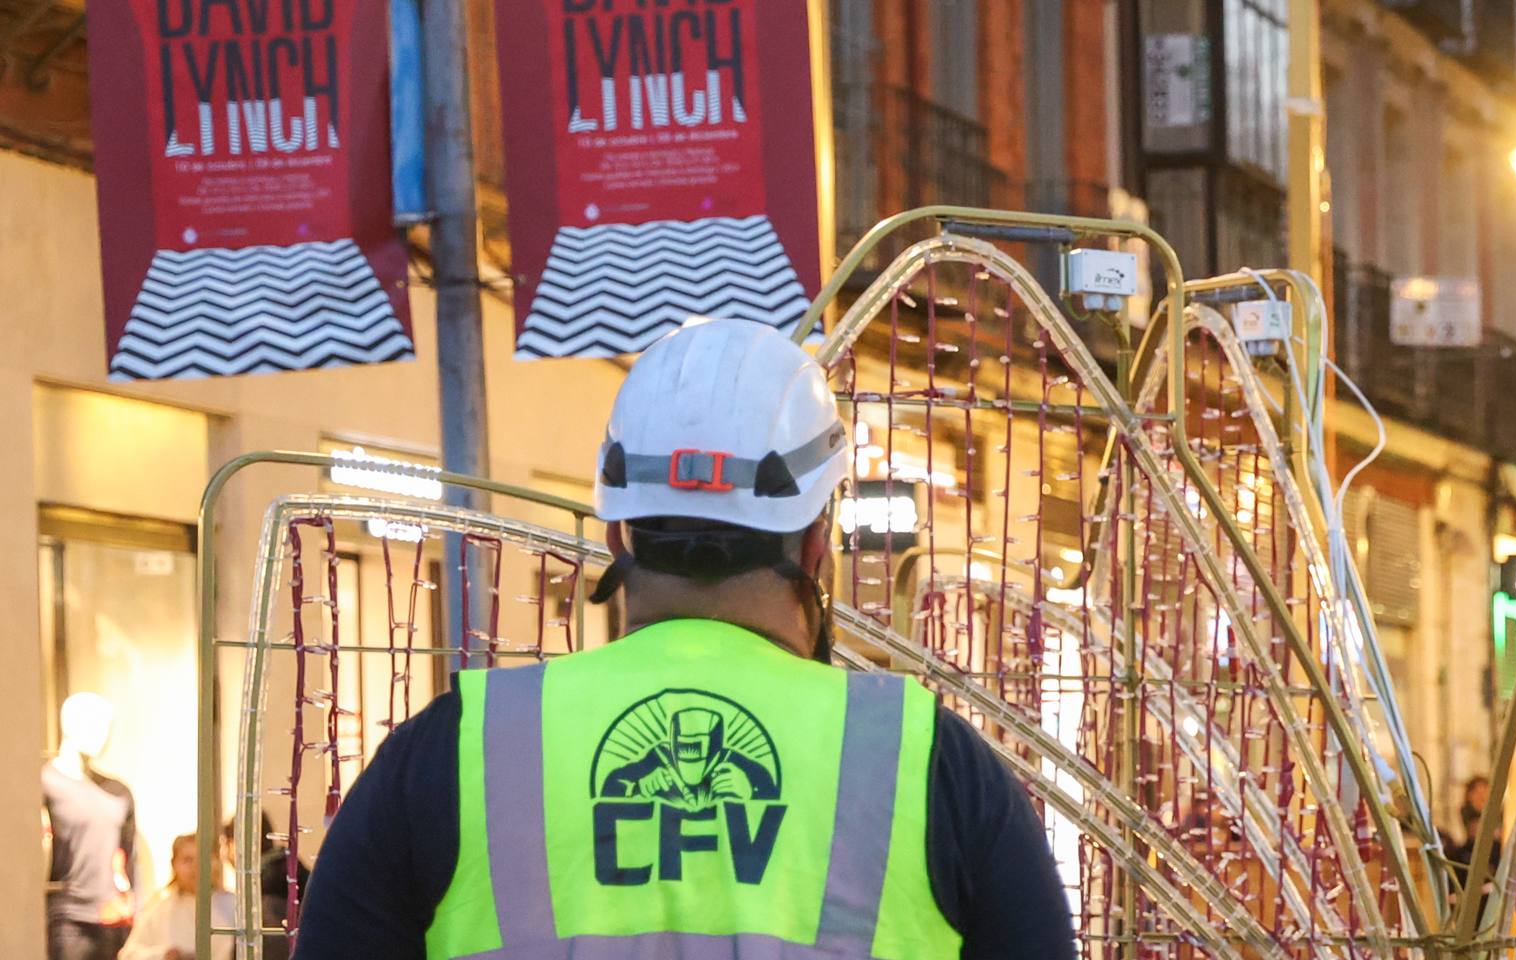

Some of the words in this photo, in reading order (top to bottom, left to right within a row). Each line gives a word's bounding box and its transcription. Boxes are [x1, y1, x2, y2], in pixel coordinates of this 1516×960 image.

[160, 36, 340, 157] LYNCH
[564, 8, 748, 133] LYNCH
[592, 801, 789, 886] CFV
